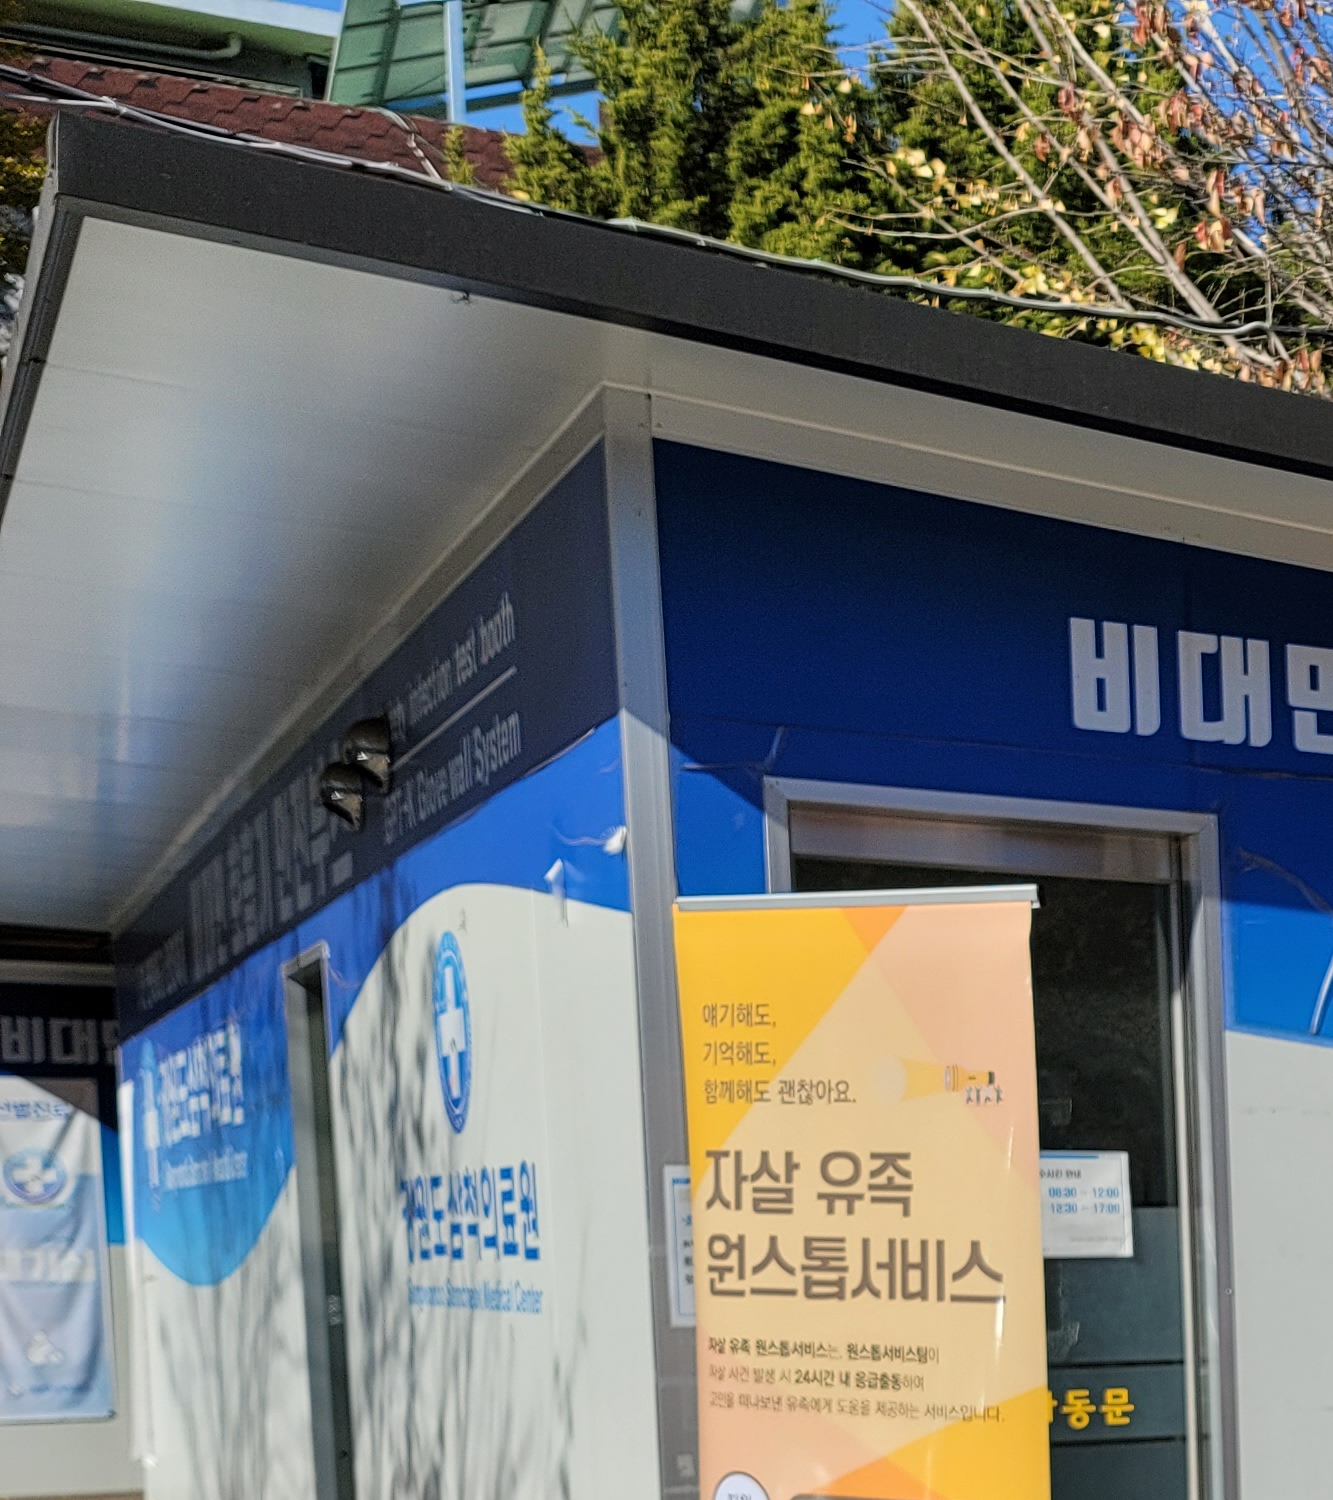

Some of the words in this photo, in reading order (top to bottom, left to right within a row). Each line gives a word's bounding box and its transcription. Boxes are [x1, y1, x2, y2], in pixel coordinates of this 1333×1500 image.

[702, 1040, 777, 1068] 기억해도,
[703, 1078, 773, 1105] 함께해도
[777, 1080, 857, 1106] 괜찮아요.
[705, 1148, 801, 1216] 자살
[816, 1149, 914, 1218] 유족
[706, 1231, 1008, 1305] 원스톱서비스
[794, 1369, 835, 1388] 24시간
[838, 1371, 851, 1388] 내
